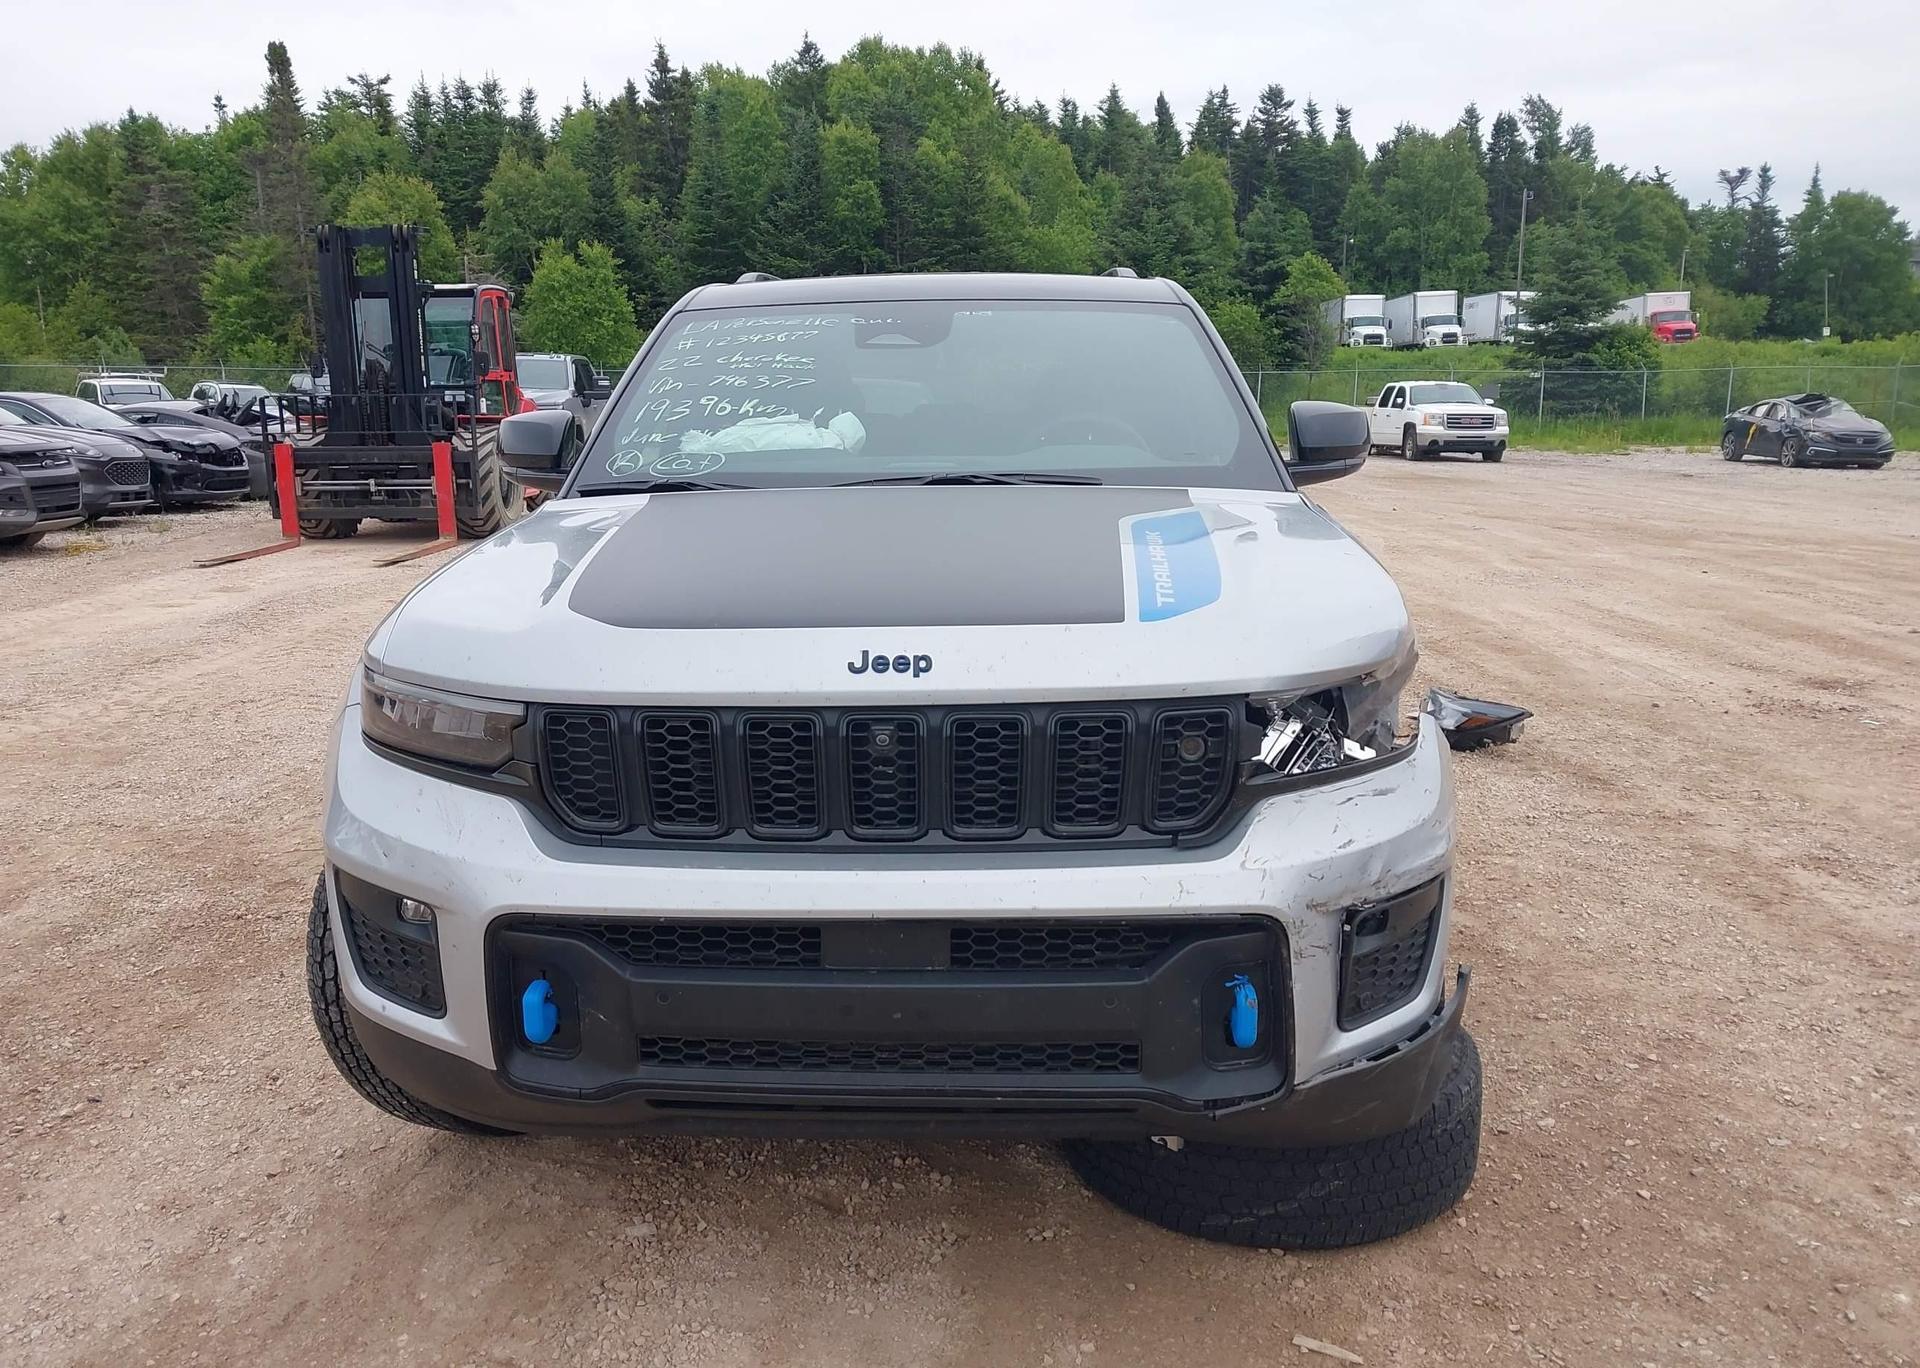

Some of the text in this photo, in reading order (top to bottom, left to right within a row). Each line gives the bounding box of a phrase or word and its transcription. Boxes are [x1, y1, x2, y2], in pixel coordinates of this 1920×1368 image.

[658, 355, 703, 371] 22
[1144, 530, 1176, 608] TRAILHAWK
[847, 649, 933, 678] Jeep
